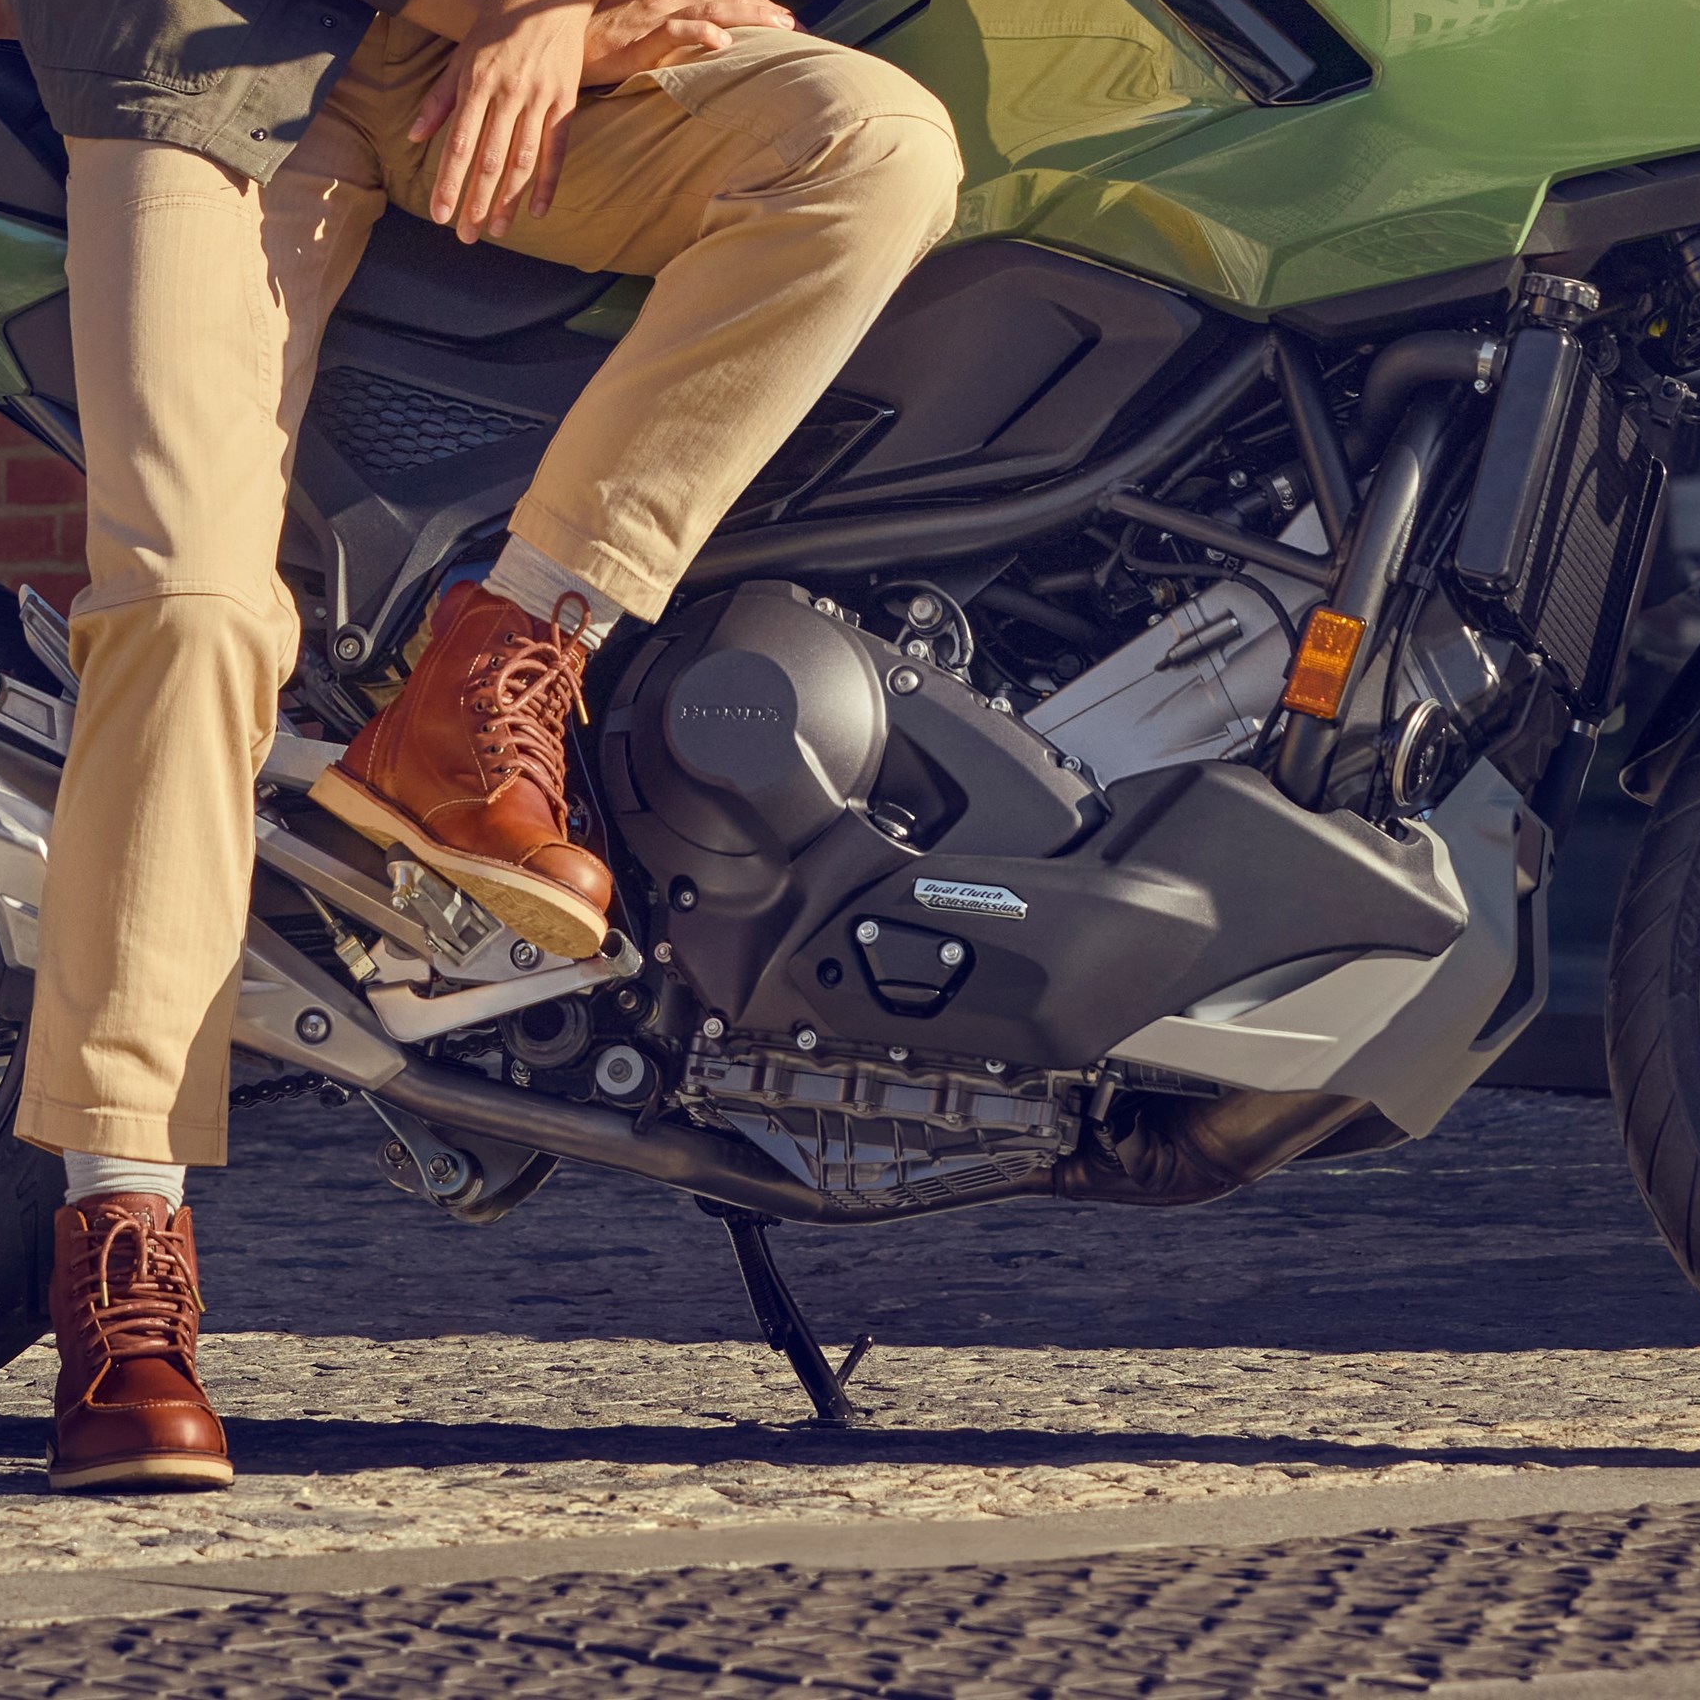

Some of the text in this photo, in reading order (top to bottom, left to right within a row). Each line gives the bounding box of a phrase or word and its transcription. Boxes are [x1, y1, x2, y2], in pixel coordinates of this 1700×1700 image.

[923, 883, 1003, 900] Dual Clutch
[927, 894, 1021, 913] Transmission
